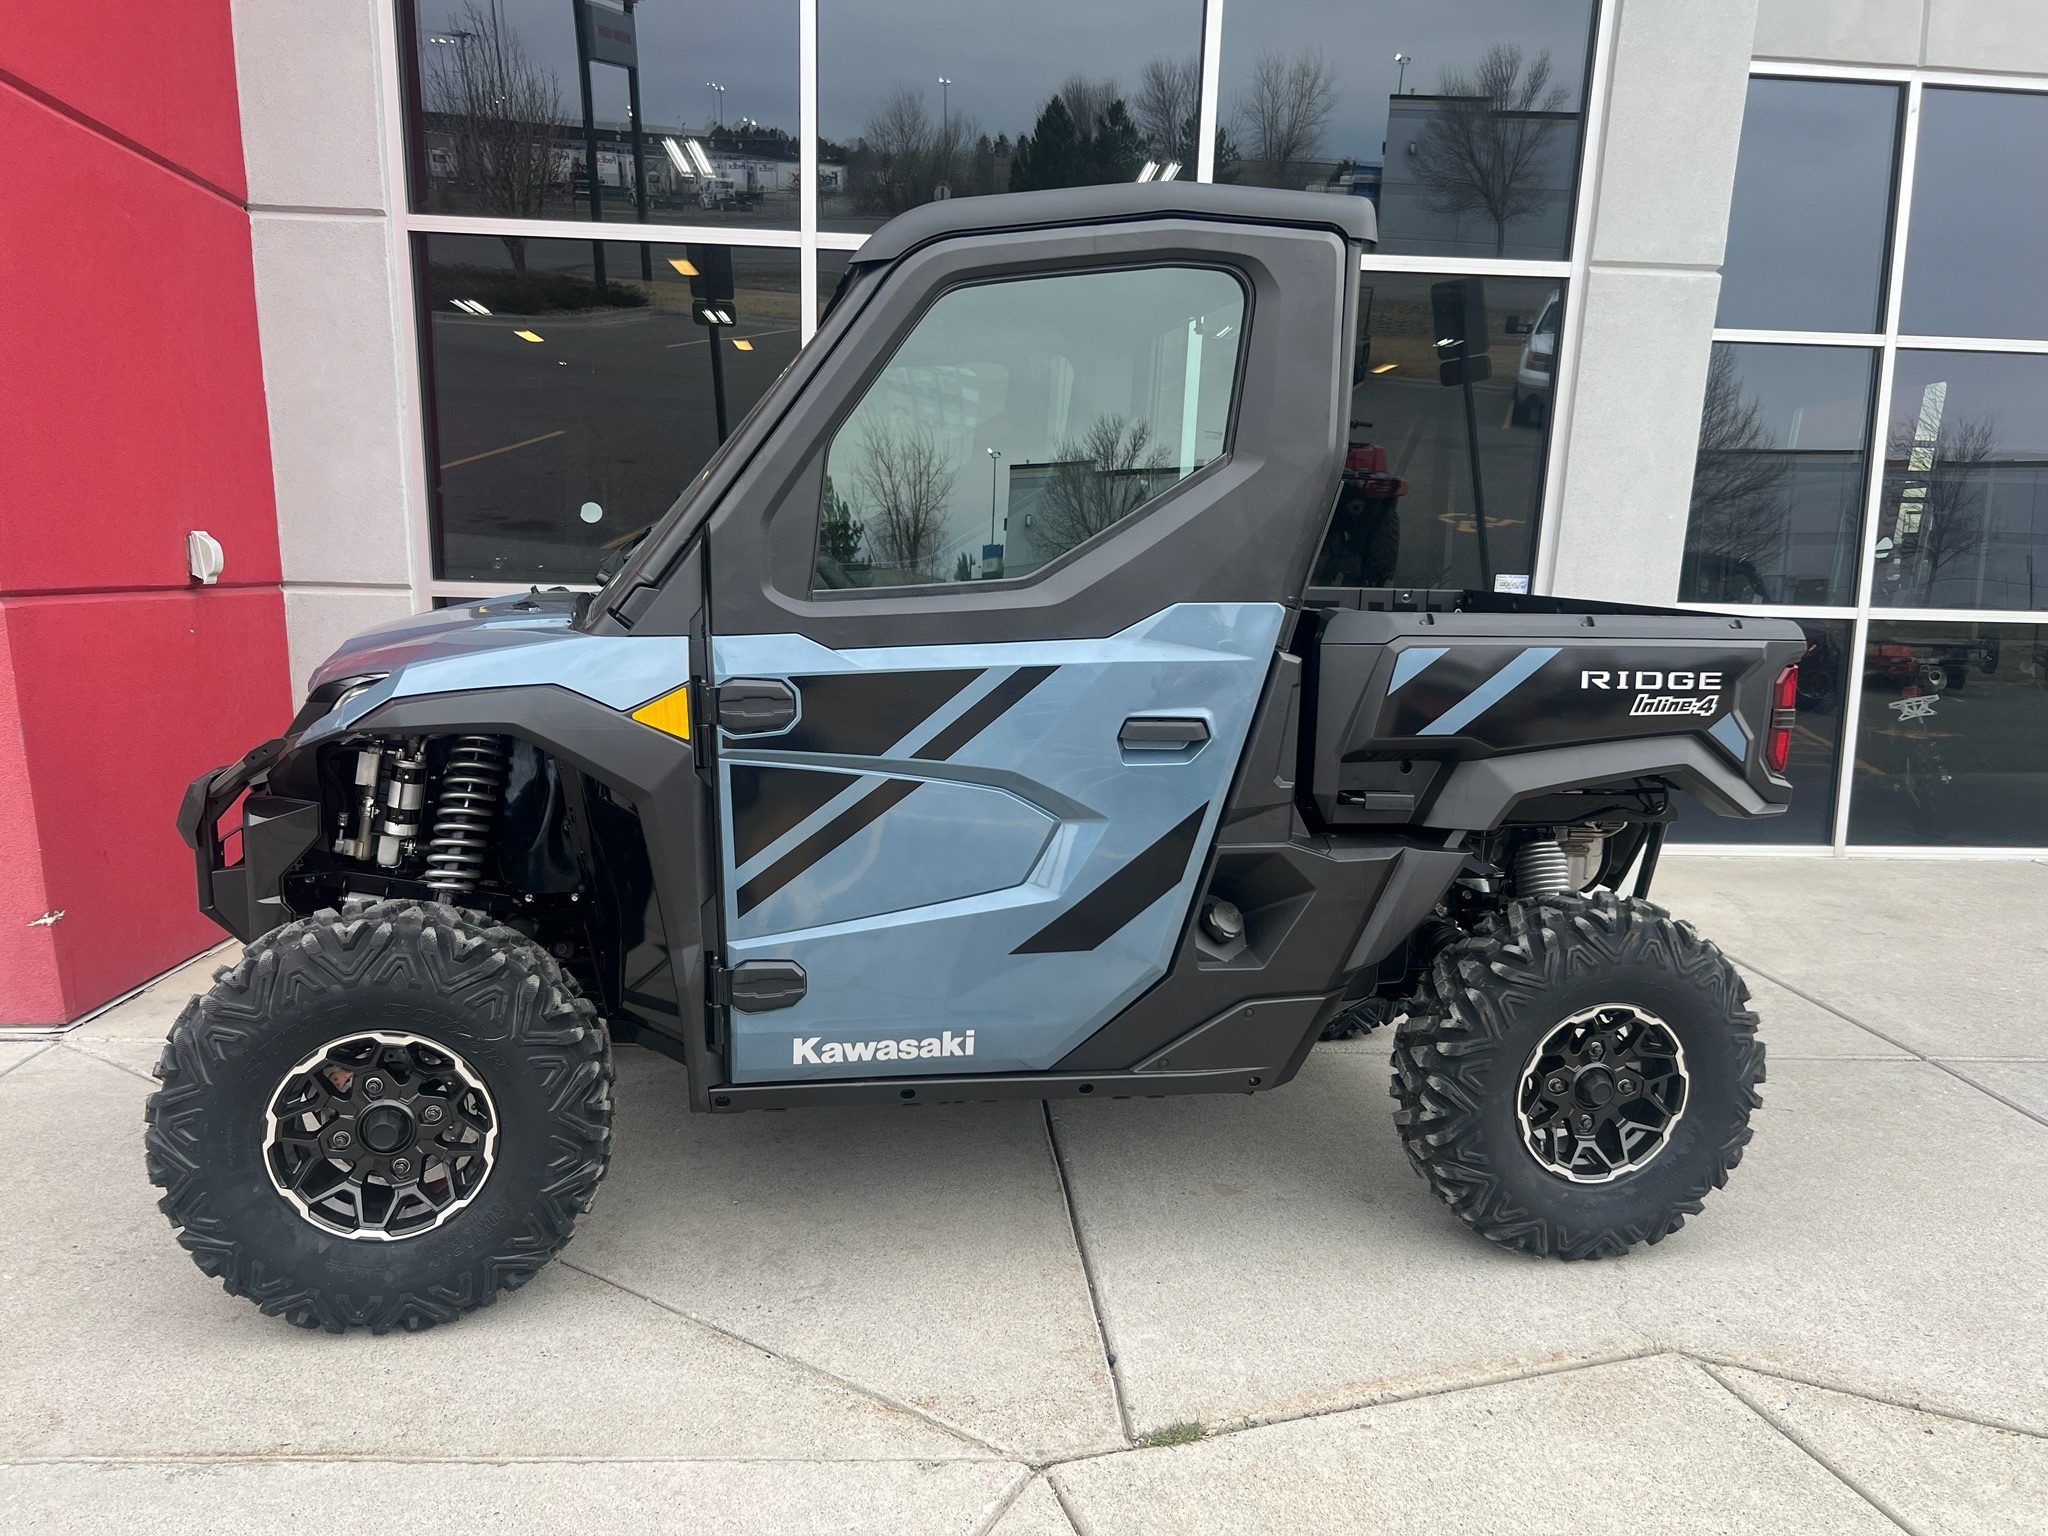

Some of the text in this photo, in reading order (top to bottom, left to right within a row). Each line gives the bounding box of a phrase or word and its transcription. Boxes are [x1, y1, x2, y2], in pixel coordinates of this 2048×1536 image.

[1580, 670, 1723, 690] RIDGE
[1629, 693, 1719, 717] Inline-4
[793, 1029, 976, 1065] Kawasaki
